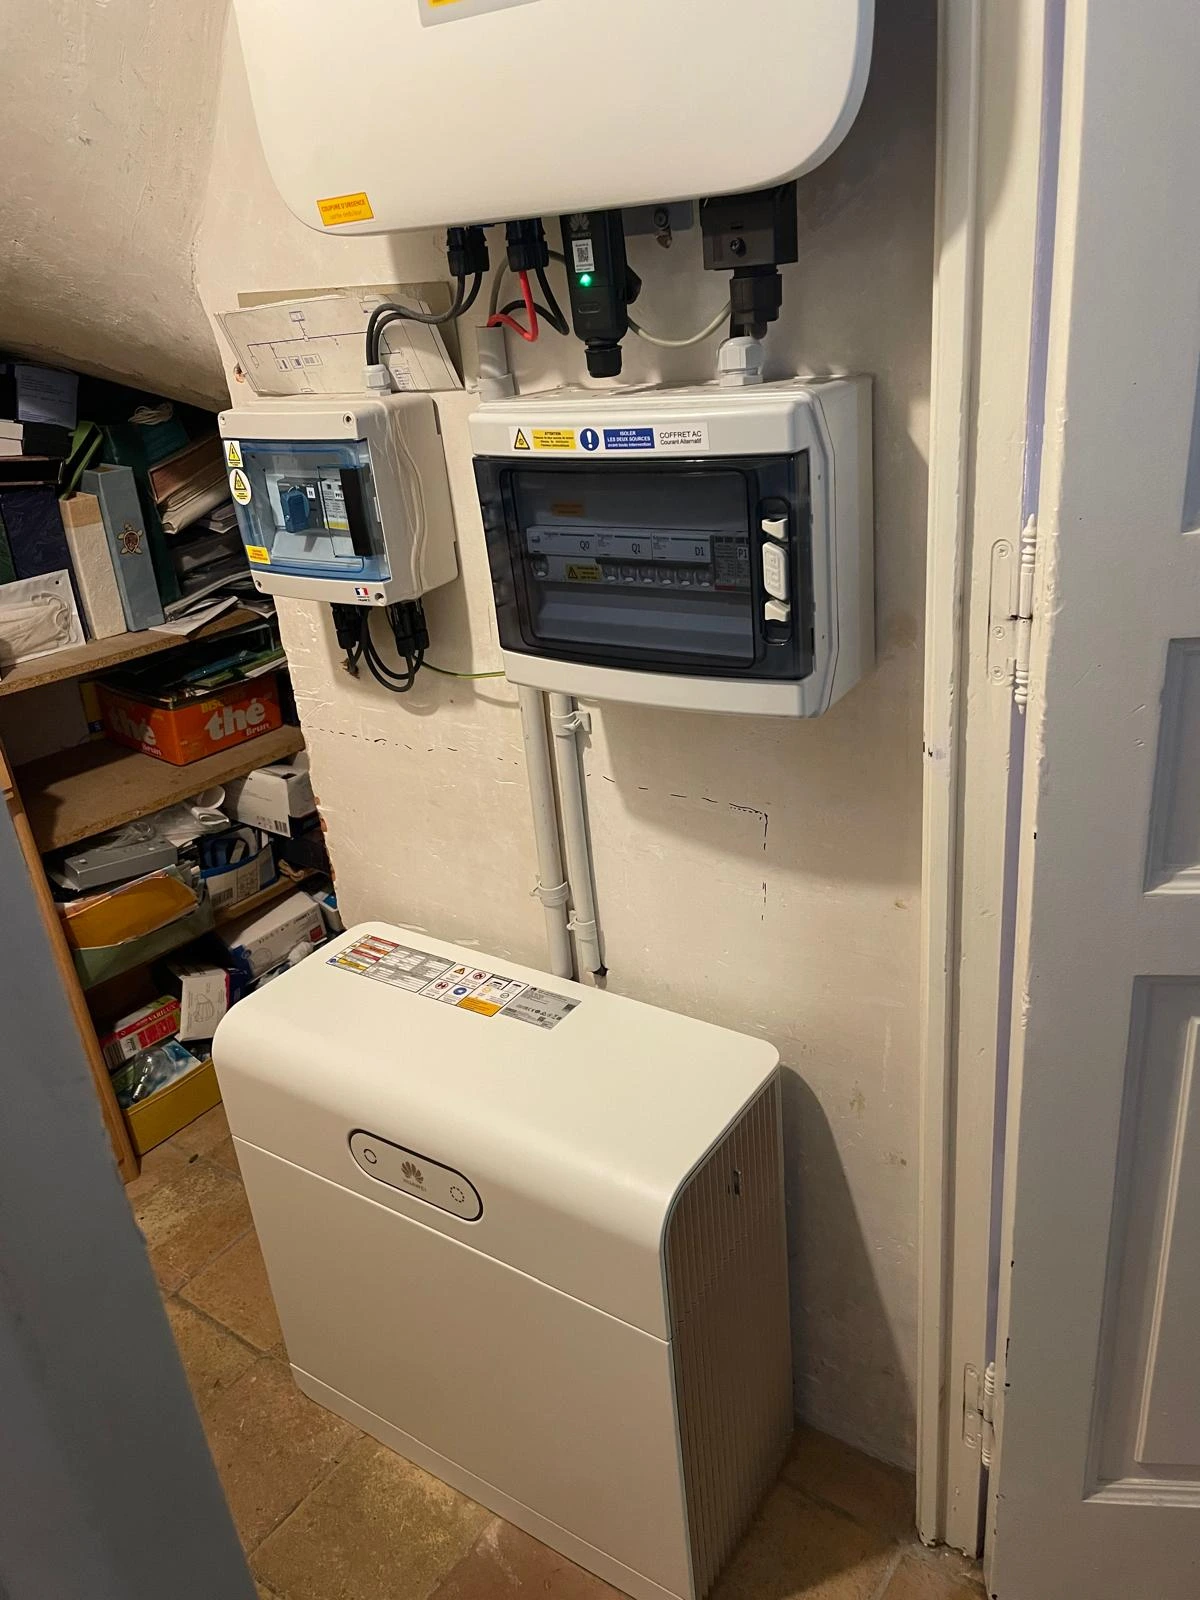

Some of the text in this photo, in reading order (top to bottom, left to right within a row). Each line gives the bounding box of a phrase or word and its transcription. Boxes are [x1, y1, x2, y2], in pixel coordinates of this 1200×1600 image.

[659, 430, 702, 439] COFFRET AC
[631, 543, 641, 554] Q1
[694, 545, 705, 557] D1
[738, 548, 747, 558] P1
[204, 697, 265, 741] thé
[245, 722, 271, 737] Brun
